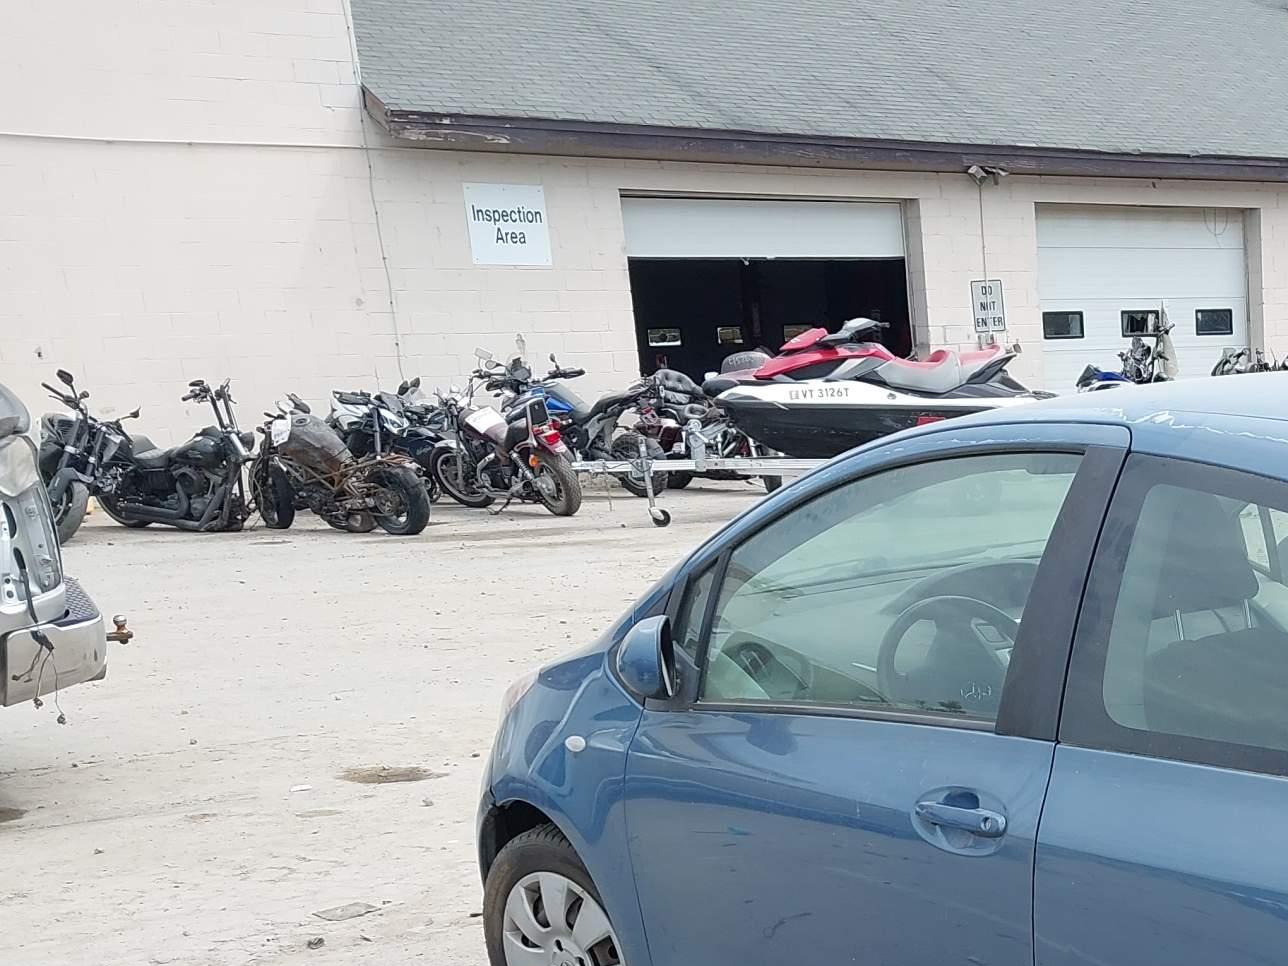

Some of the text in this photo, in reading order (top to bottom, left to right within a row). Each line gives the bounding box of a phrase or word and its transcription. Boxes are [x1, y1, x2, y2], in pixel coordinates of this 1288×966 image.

[471, 204, 543, 225] Inspection
[495, 227, 527, 244] Area
[981, 285, 993, 296] DO
